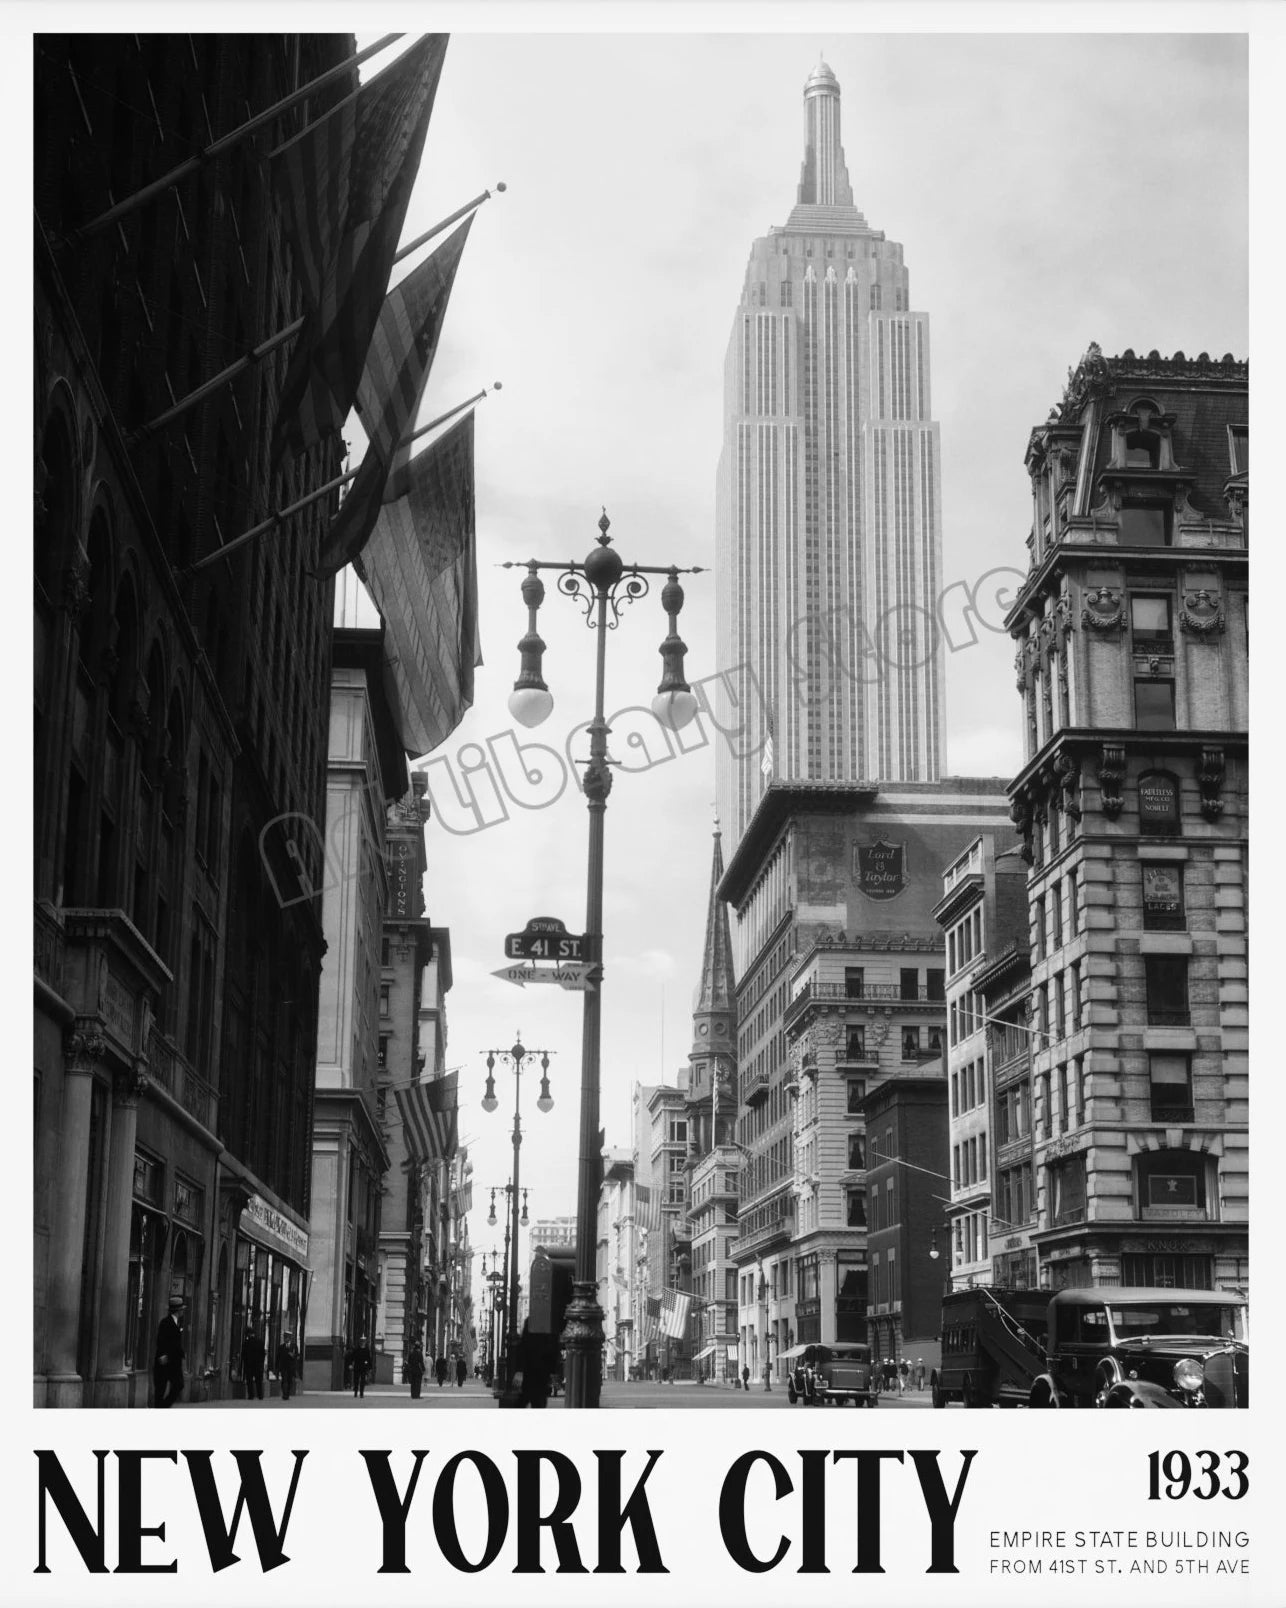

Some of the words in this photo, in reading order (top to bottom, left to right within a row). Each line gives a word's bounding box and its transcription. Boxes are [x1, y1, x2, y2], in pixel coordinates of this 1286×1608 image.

[868, 849, 895, 859] Lord
[865, 872, 901, 885] Taylor
[511, 938, 525, 955] E.
[530, 939, 549, 956] 41
[559, 940, 582, 957] ST.
[1147, 1239, 1187, 1249] KNOX
